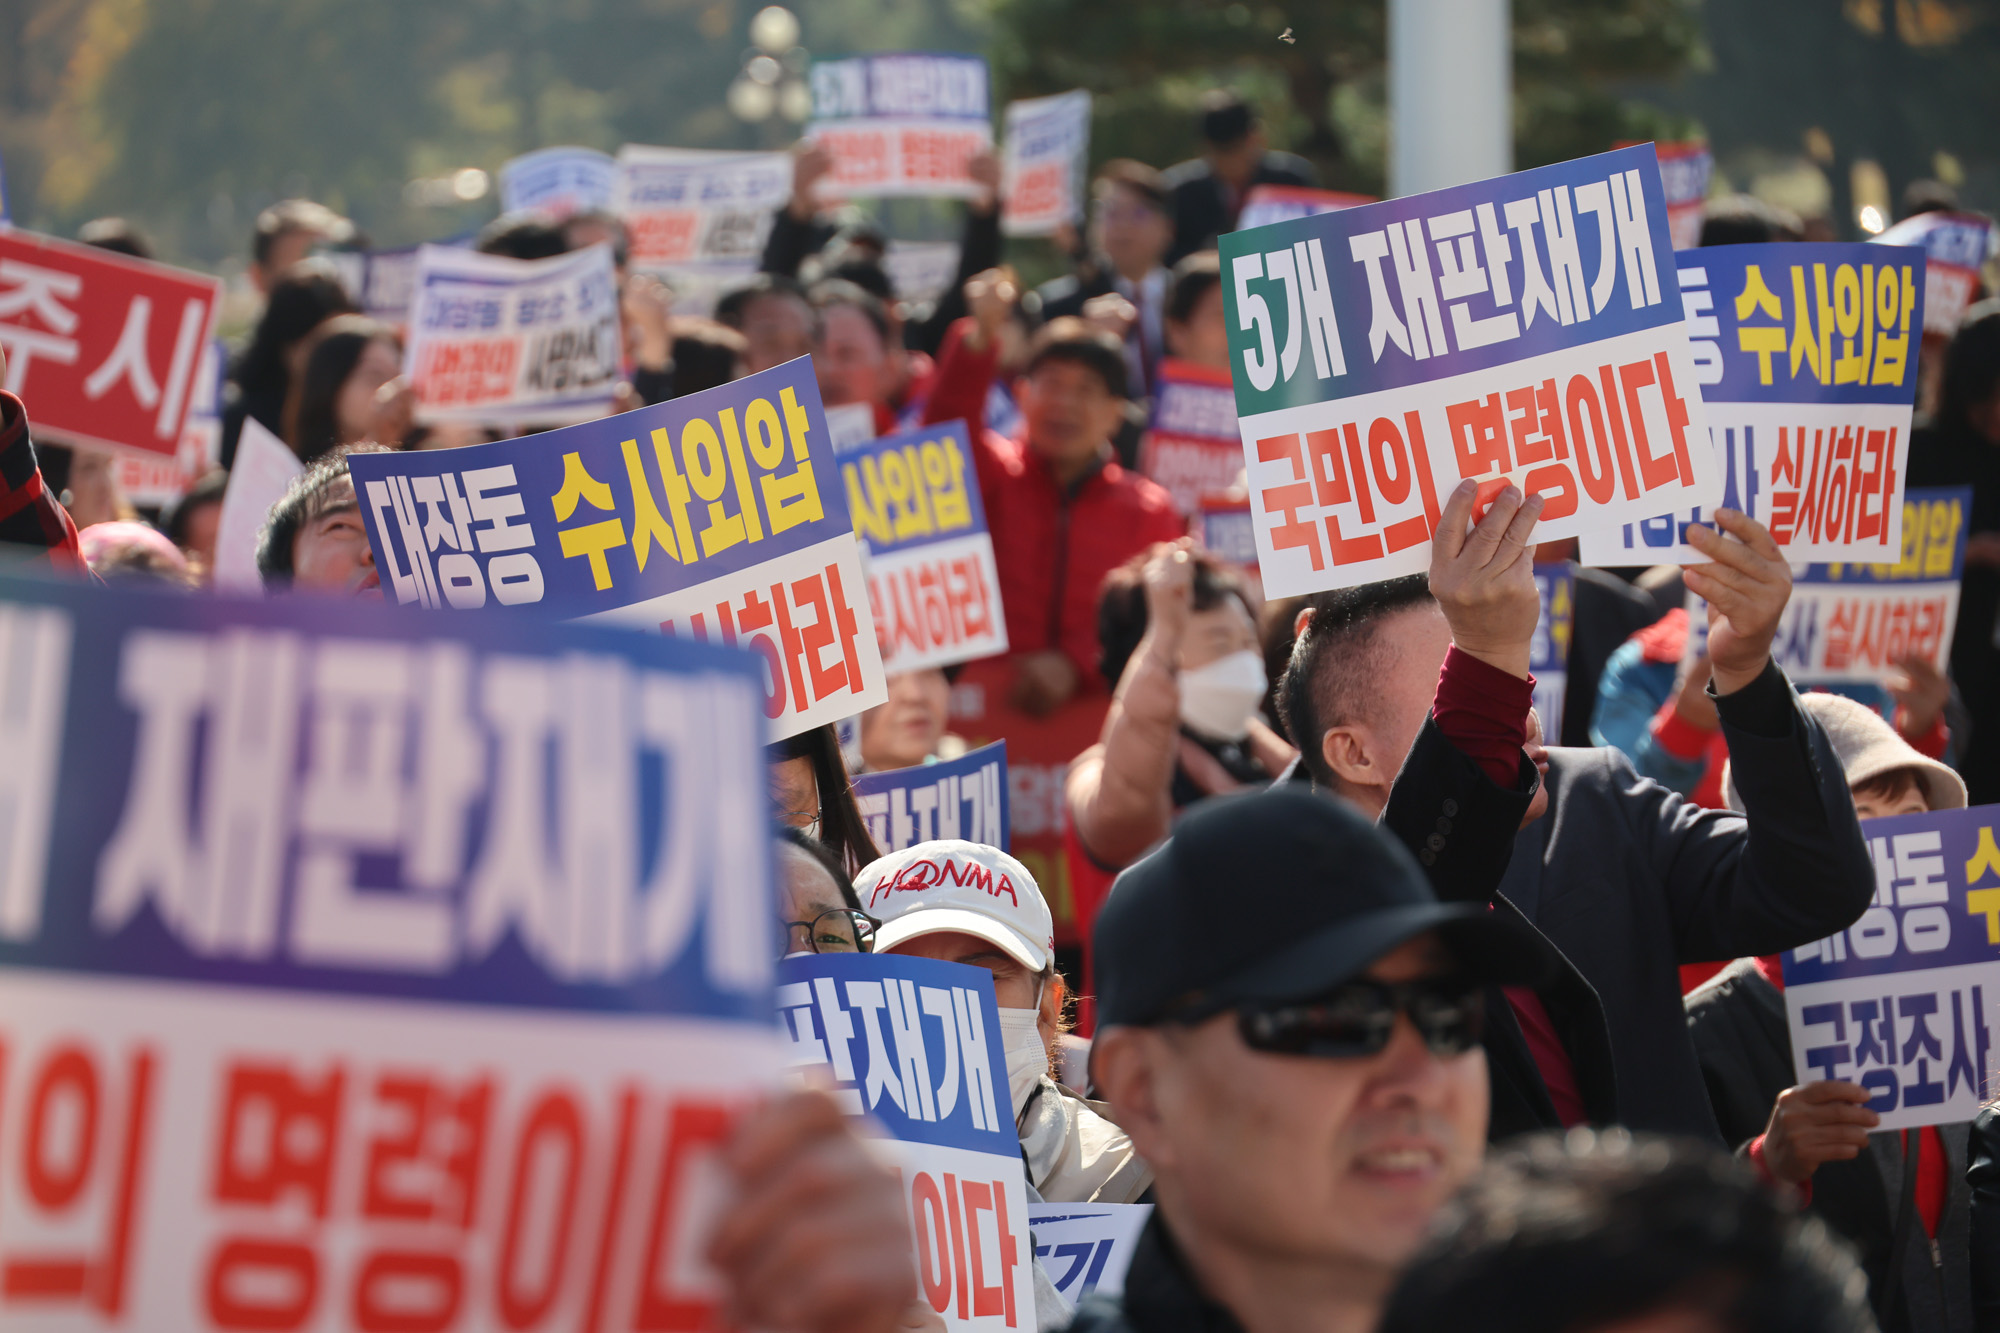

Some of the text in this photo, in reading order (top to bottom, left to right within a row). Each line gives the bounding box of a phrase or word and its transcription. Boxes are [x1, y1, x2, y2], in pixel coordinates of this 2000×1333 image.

[1232, 169, 1662, 391] 5개 재판재개
[1735, 263, 1915, 386] 수사외압
[364, 386, 824, 611] 대장동 수사외압
[842, 435, 973, 545] 사외압
[1256, 410, 1442, 572] 국민의
[1446, 351, 1695, 527] 명령이다
[1770, 425, 1897, 545] 실시하라
[91, 628, 775, 995] 재판재개
[869, 858, 1018, 908] HONMA
[1794, 831, 1950, 963] 장동
[0, 1040, 160, 1325] 의
[1036, 1238, 1115, 1304] 기
